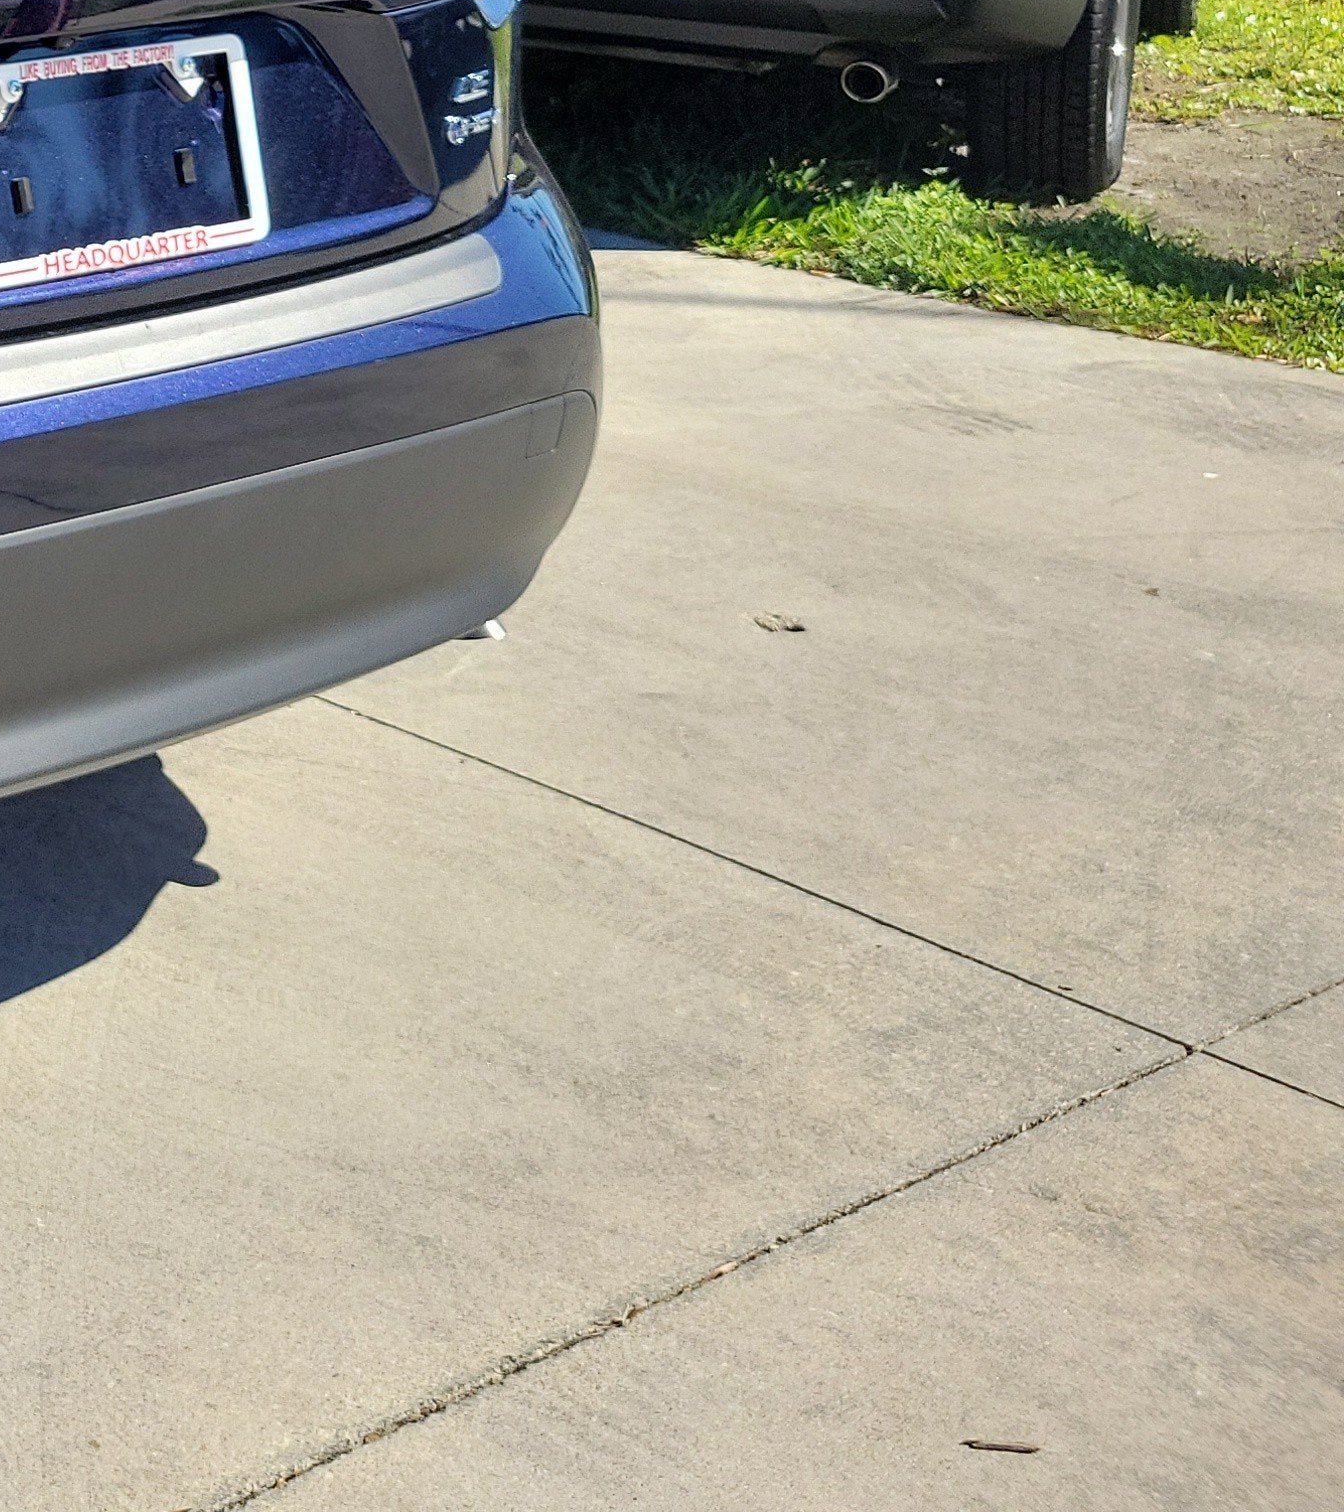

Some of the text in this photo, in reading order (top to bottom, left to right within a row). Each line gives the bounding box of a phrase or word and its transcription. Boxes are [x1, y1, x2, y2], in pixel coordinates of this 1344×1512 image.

[19, 63, 39, 80] LIKE
[43, 57, 78, 76] BUYING
[81, 53, 108, 71] FROM
[112, 51, 129, 67] THE
[43, 229, 209, 276] HEADQUARTER
